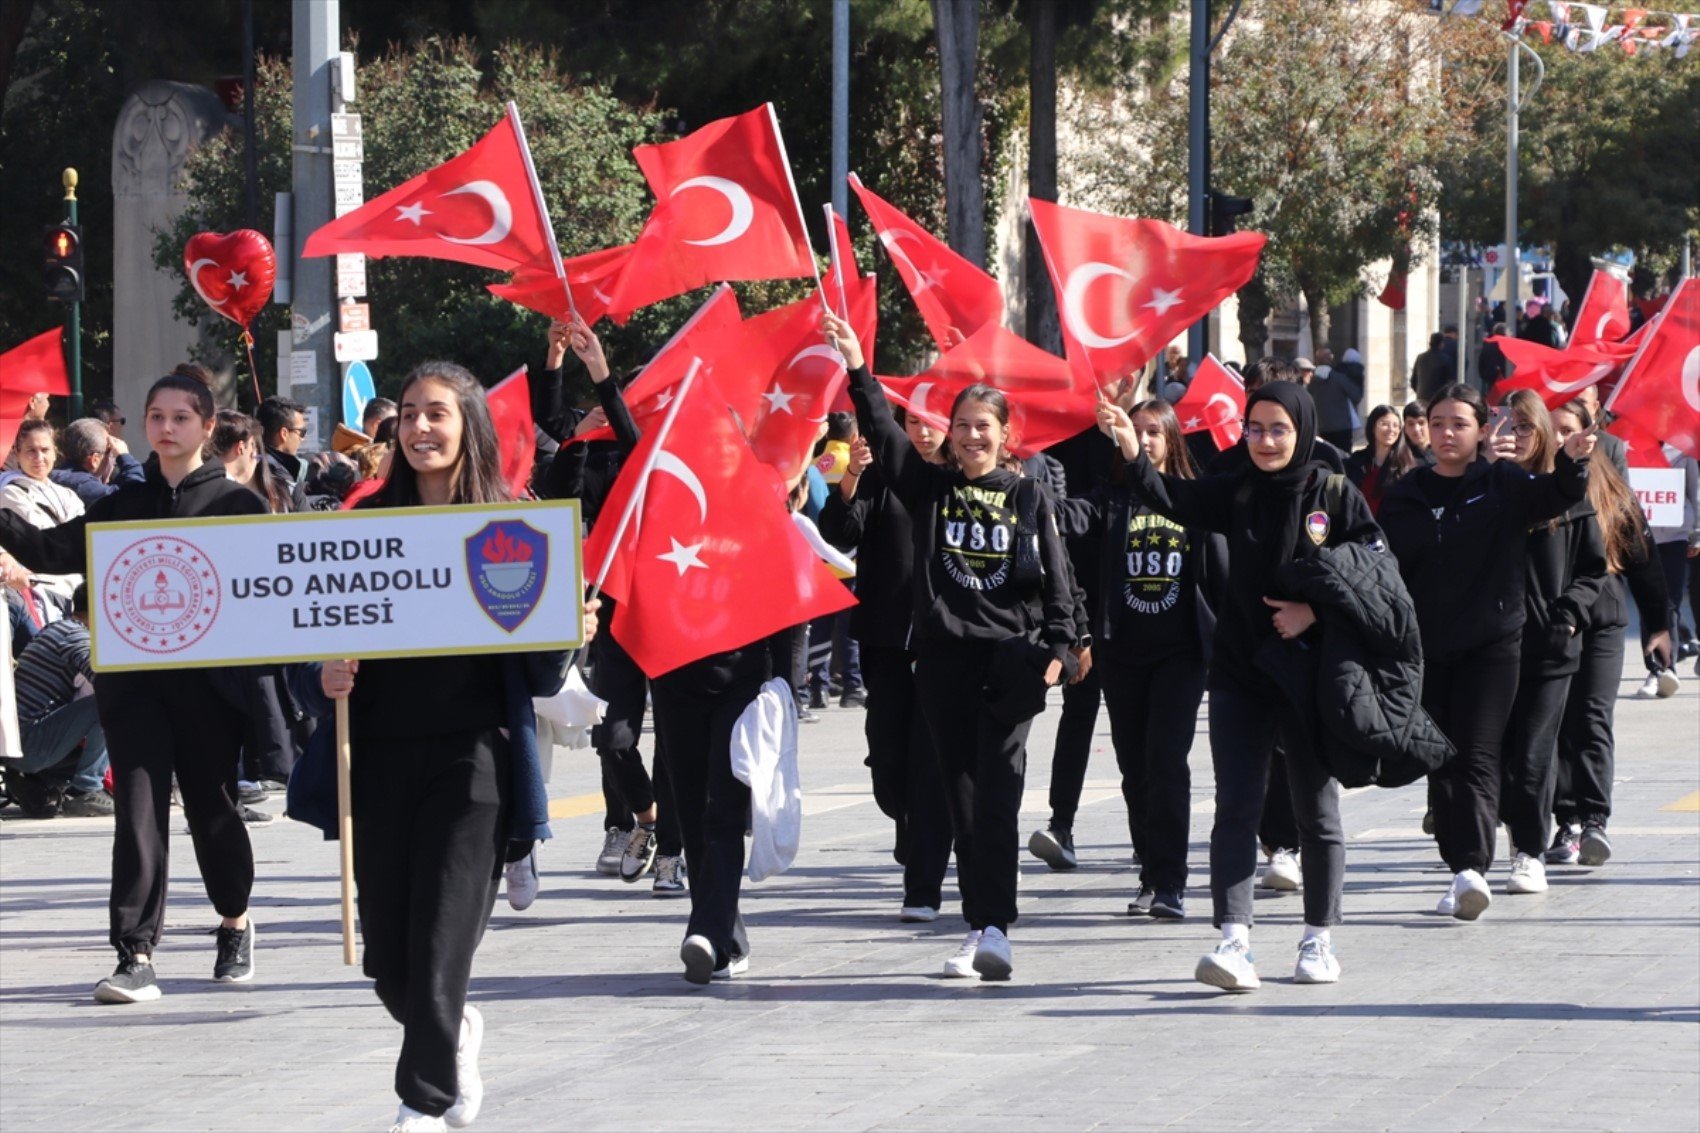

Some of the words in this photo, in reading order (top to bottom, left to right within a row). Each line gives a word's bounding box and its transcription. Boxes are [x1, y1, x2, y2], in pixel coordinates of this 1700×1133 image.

[277, 537, 405, 564] BURDUR
[945, 521, 1010, 552] USO
[1126, 551, 1183, 577] USO
[231, 575, 294, 599] USO
[304, 567, 452, 595] ANADOLU
[292, 597, 394, 629] LİSESİ
